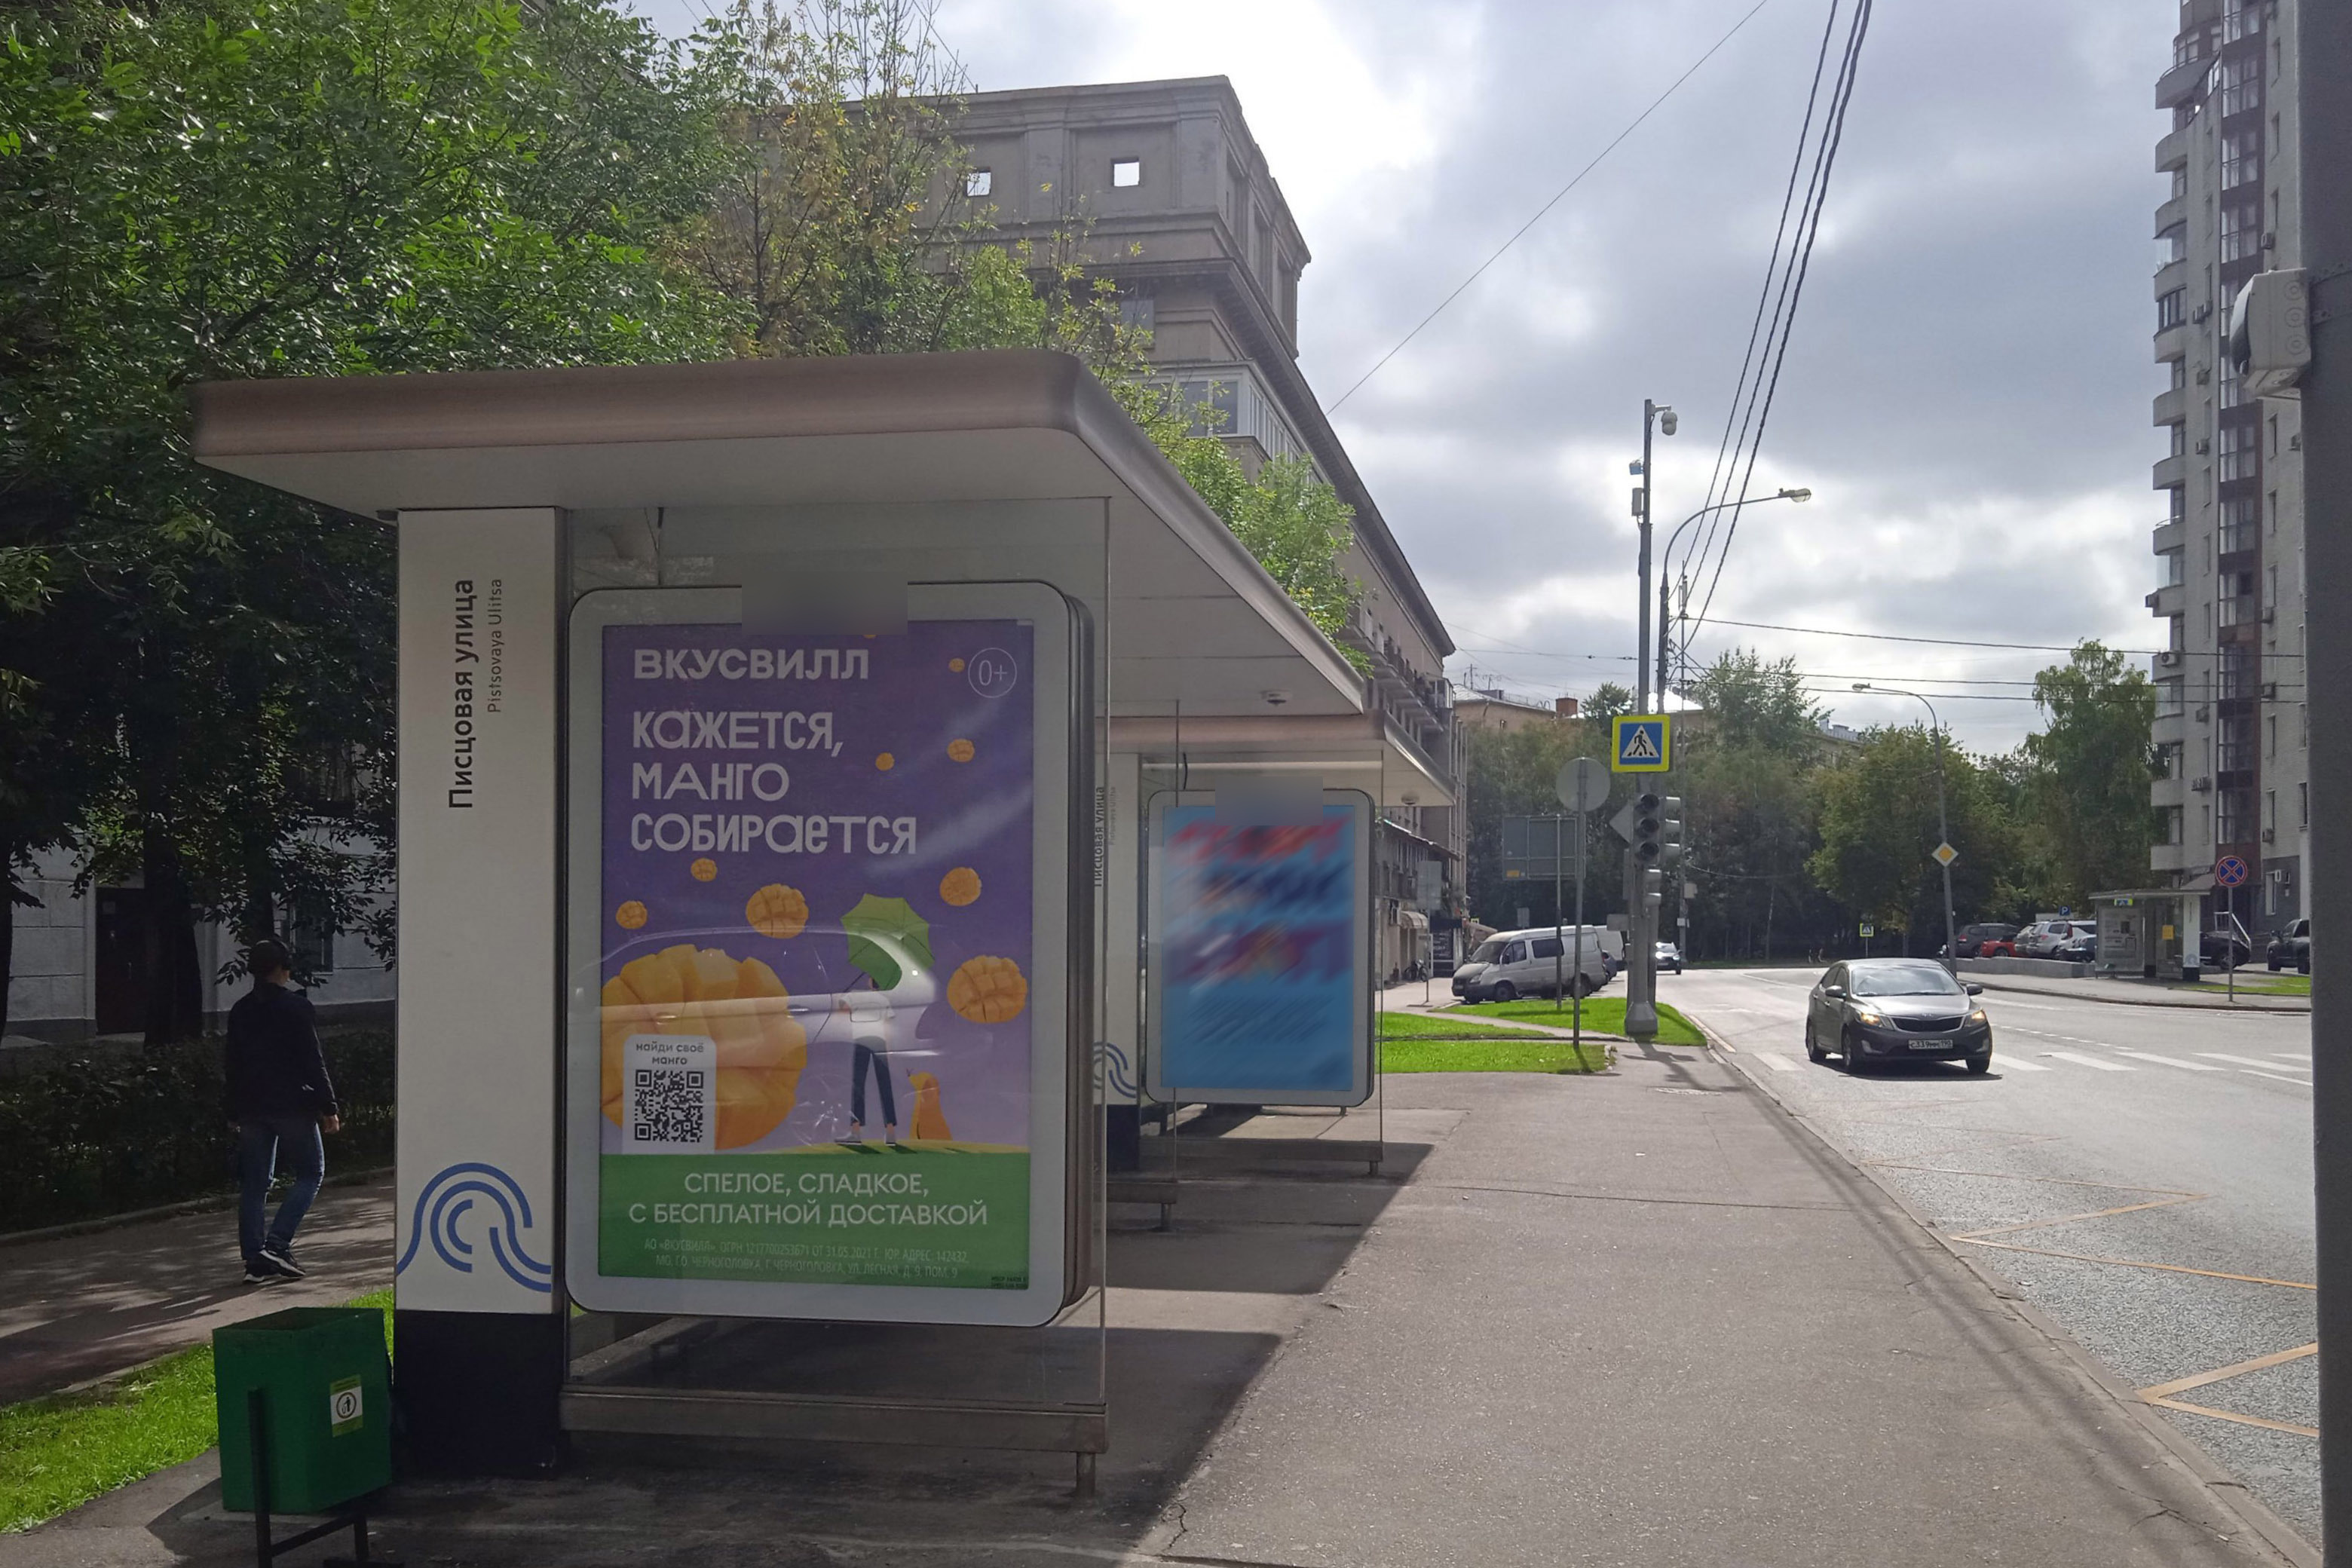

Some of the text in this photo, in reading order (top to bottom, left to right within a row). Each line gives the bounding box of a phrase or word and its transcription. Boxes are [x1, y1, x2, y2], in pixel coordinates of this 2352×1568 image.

[488, 579, 505, 712] Pistsovaya Ulitsa
[634, 648, 869, 680] ВКУСВИЛЛ
[978, 660, 1008, 686] 0+
[449, 580, 479, 808] Писцовая улица
[632, 762, 789, 801] МАНГО
[635, 1040, 705, 1053] найди своё
[652, 1056, 688, 1065] манго
[684, 1173, 929, 1197] СПЕЛОЕ, СЛАДКОЕ,
[629, 1199, 988, 1228] С БЕСПЛАТНОЙ ДОСТАВКОЙ
[644, 1238, 657, 1251] АО
[721, 1242, 743, 1253] ОГРН
[812, 1245, 824, 1257] ОТ
